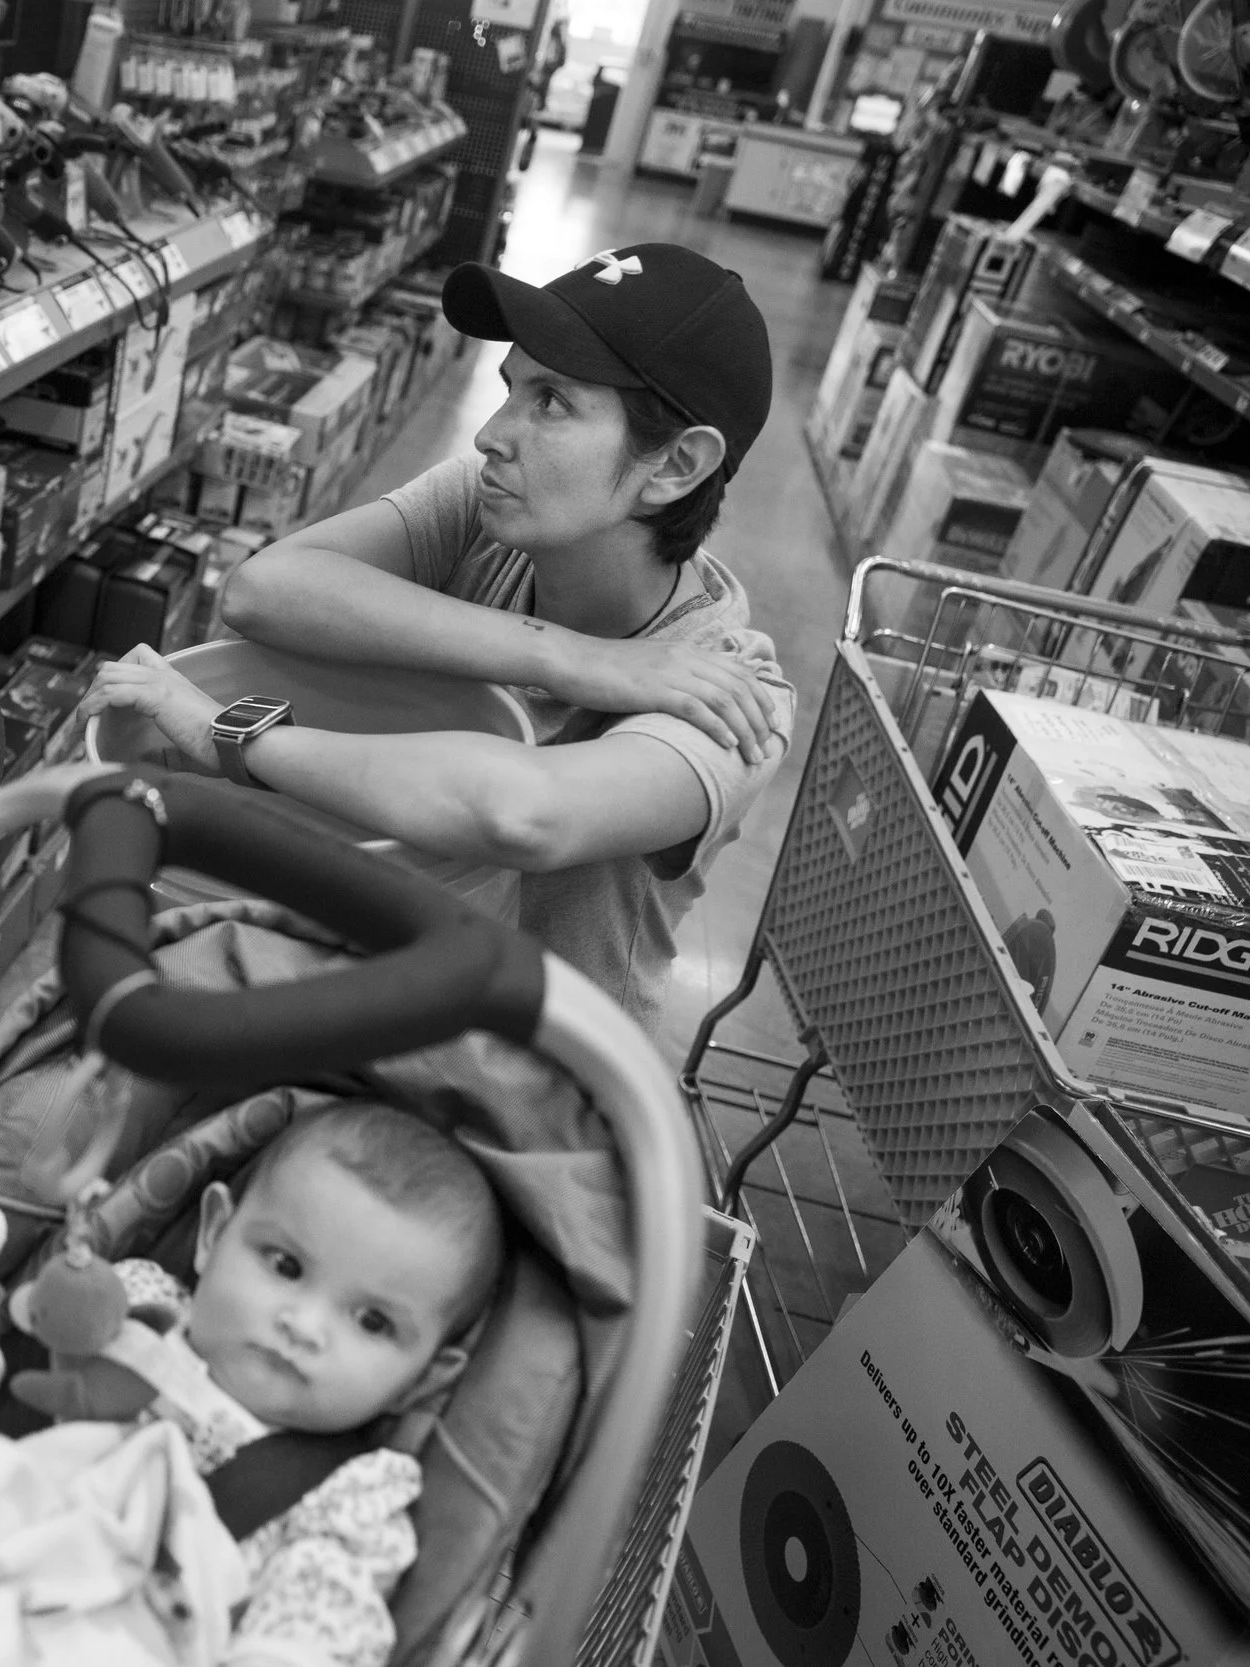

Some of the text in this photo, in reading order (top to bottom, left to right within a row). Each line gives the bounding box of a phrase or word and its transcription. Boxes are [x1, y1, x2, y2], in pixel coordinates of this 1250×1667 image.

[999, 338, 1098, 383] RYOBI
[1100, 1001, 1113, 1009] De
[1110, 983, 1131, 992] 14"
[1132, 989, 1185, 1006] Abrasive
[1188, 998, 1231, 1016] Cut-off
[1176, 1010, 1203, 1021] Meule
[1204, 1017, 1244, 1030] Abrasive
[1185, 1029, 1197, 1037] De
[1199, 1032, 1224, 1044] Disco
[860, 1349, 903, 1420] Delivers
[902, 1418, 918, 1445] up
[918, 1441, 930, 1465] to
[930, 1464, 956, 1504] 10X
[953, 1500, 993, 1558] faster
[990, 1561, 1050, 1651] material
[907, 1459, 936, 1502] over
[933, 1501, 989, 1587] standard
[958, 1468, 1025, 1567] FLAP
[945, 1412, 1125, 1667] STEEL DEMO
[1027, 1469, 1133, 1614] DIABLO
